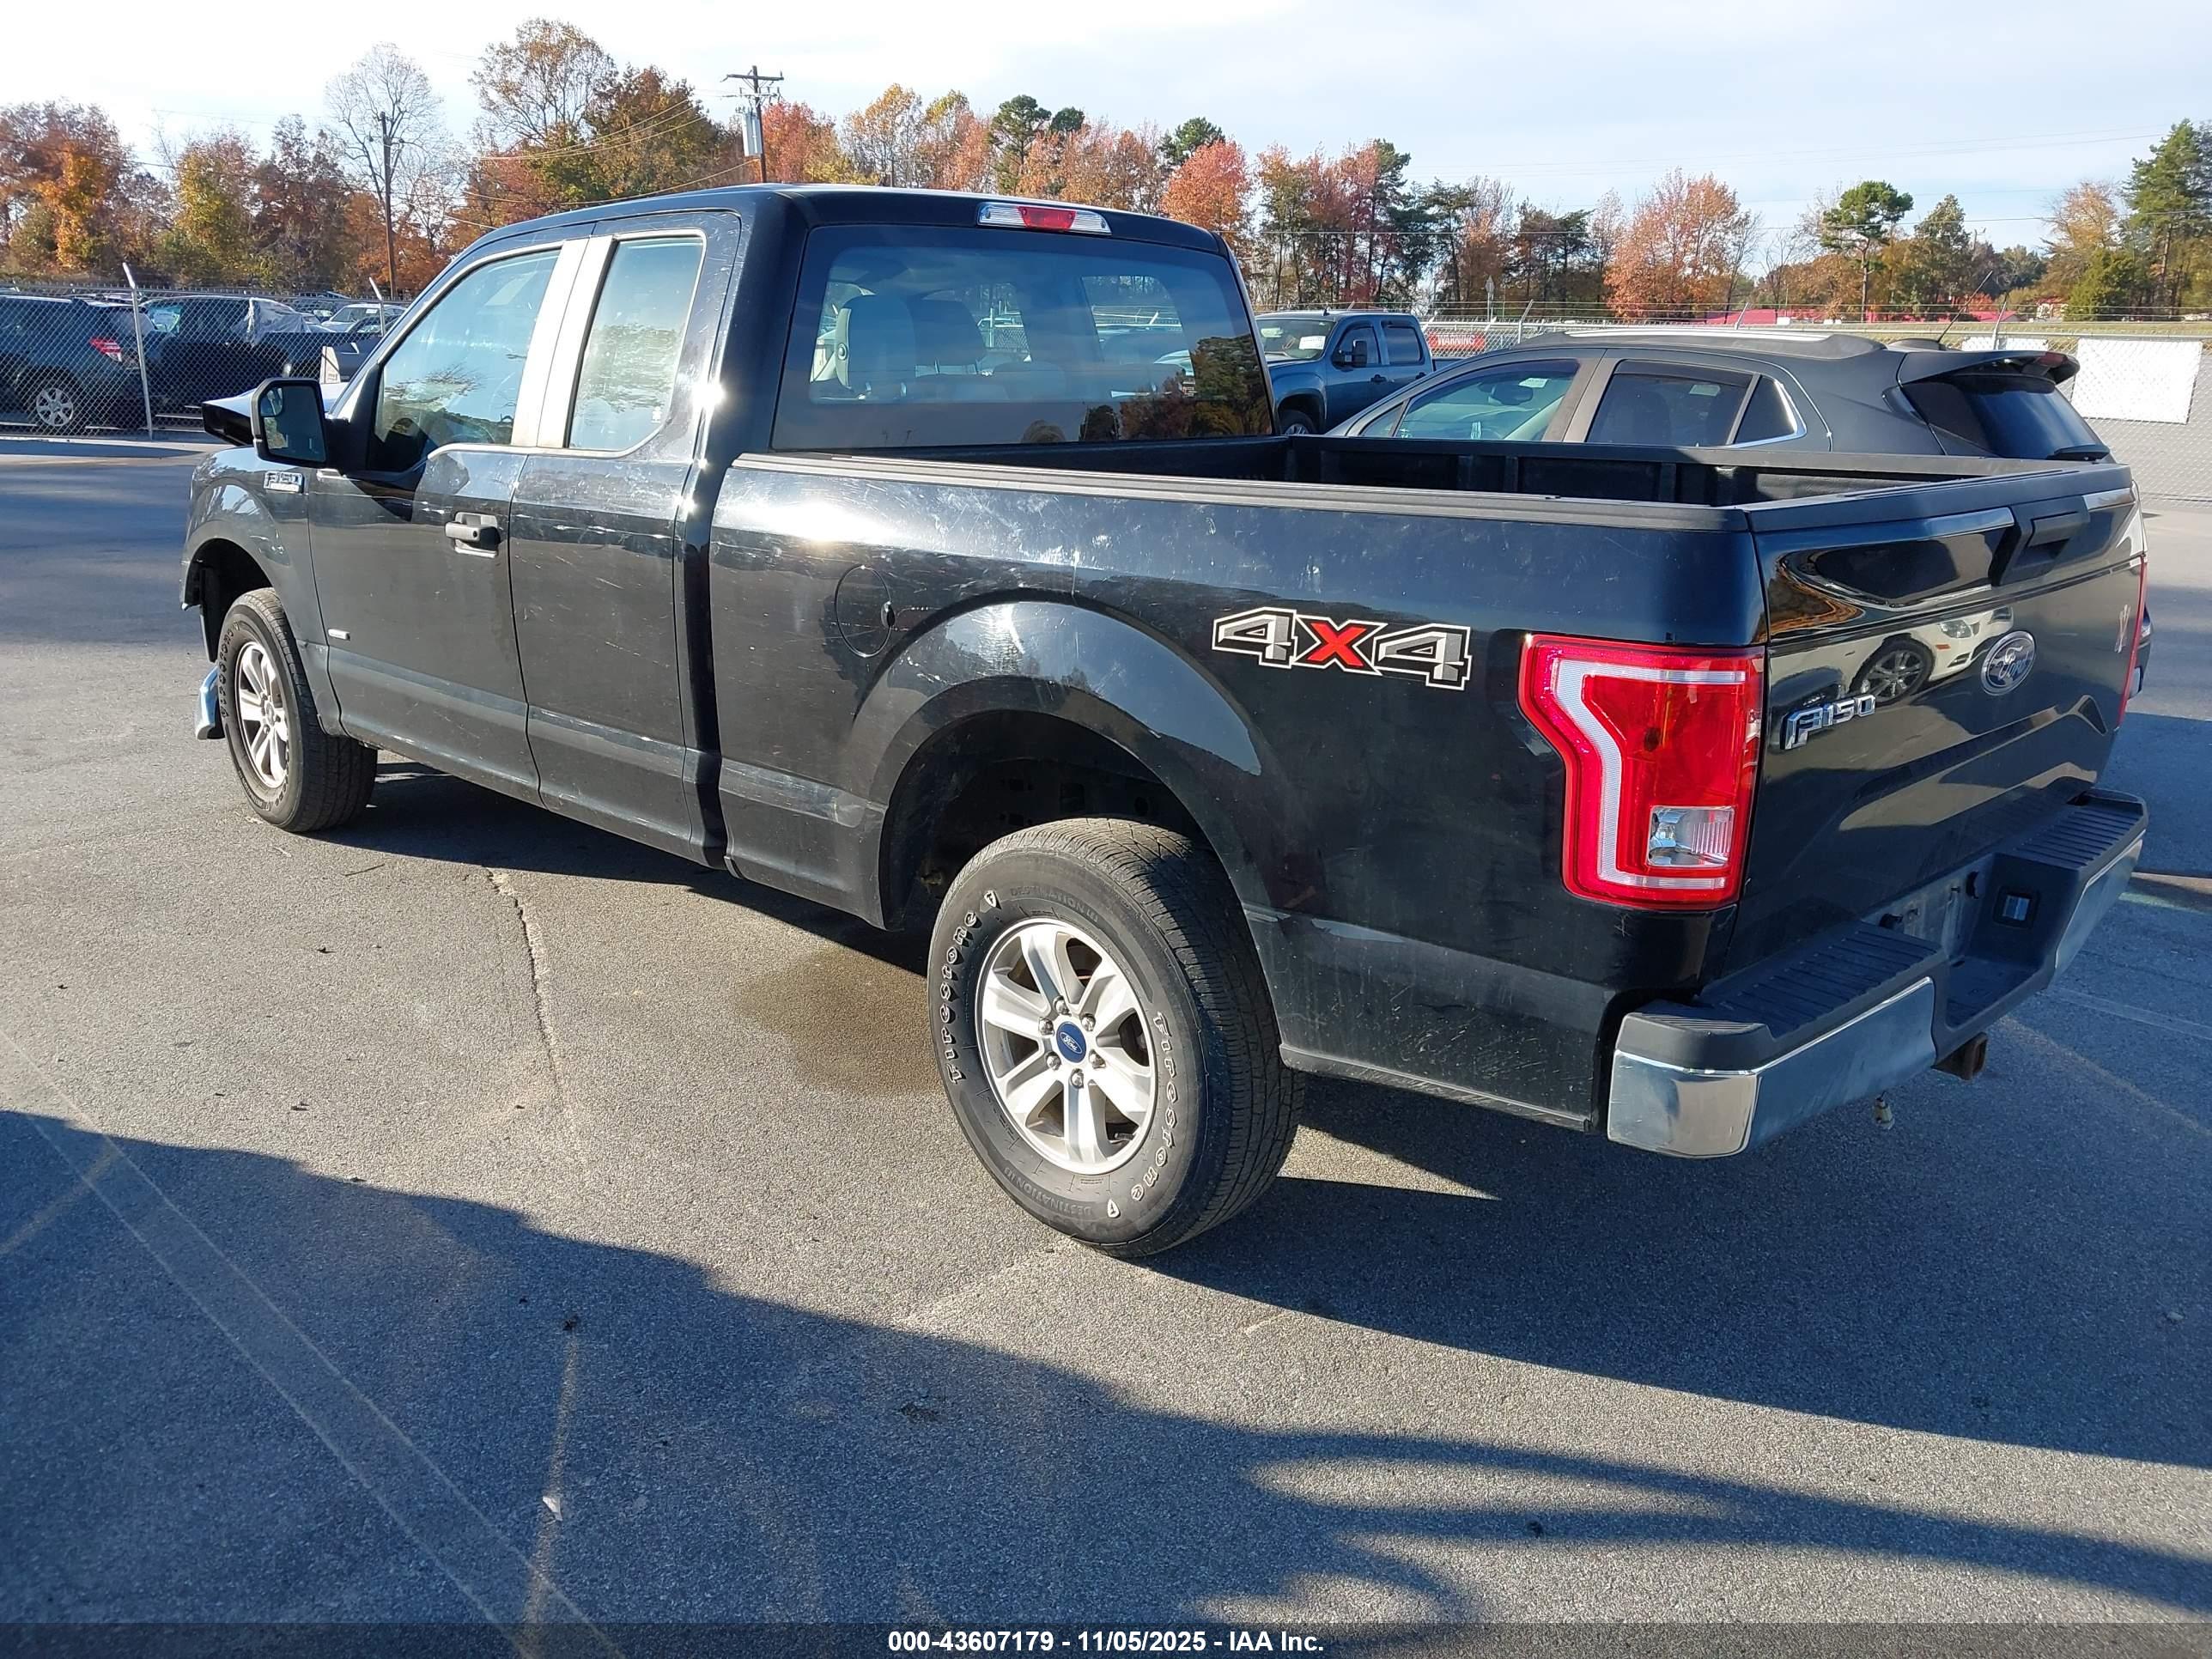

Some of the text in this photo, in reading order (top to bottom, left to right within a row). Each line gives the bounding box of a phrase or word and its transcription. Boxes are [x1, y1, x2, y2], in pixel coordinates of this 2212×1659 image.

[1436, 333, 1476, 346] WARNING
[1780, 695, 1875, 750] F150
[939, 912, 977, 1085] Firestone
[1130, 1012, 1177, 1201] Firestone
